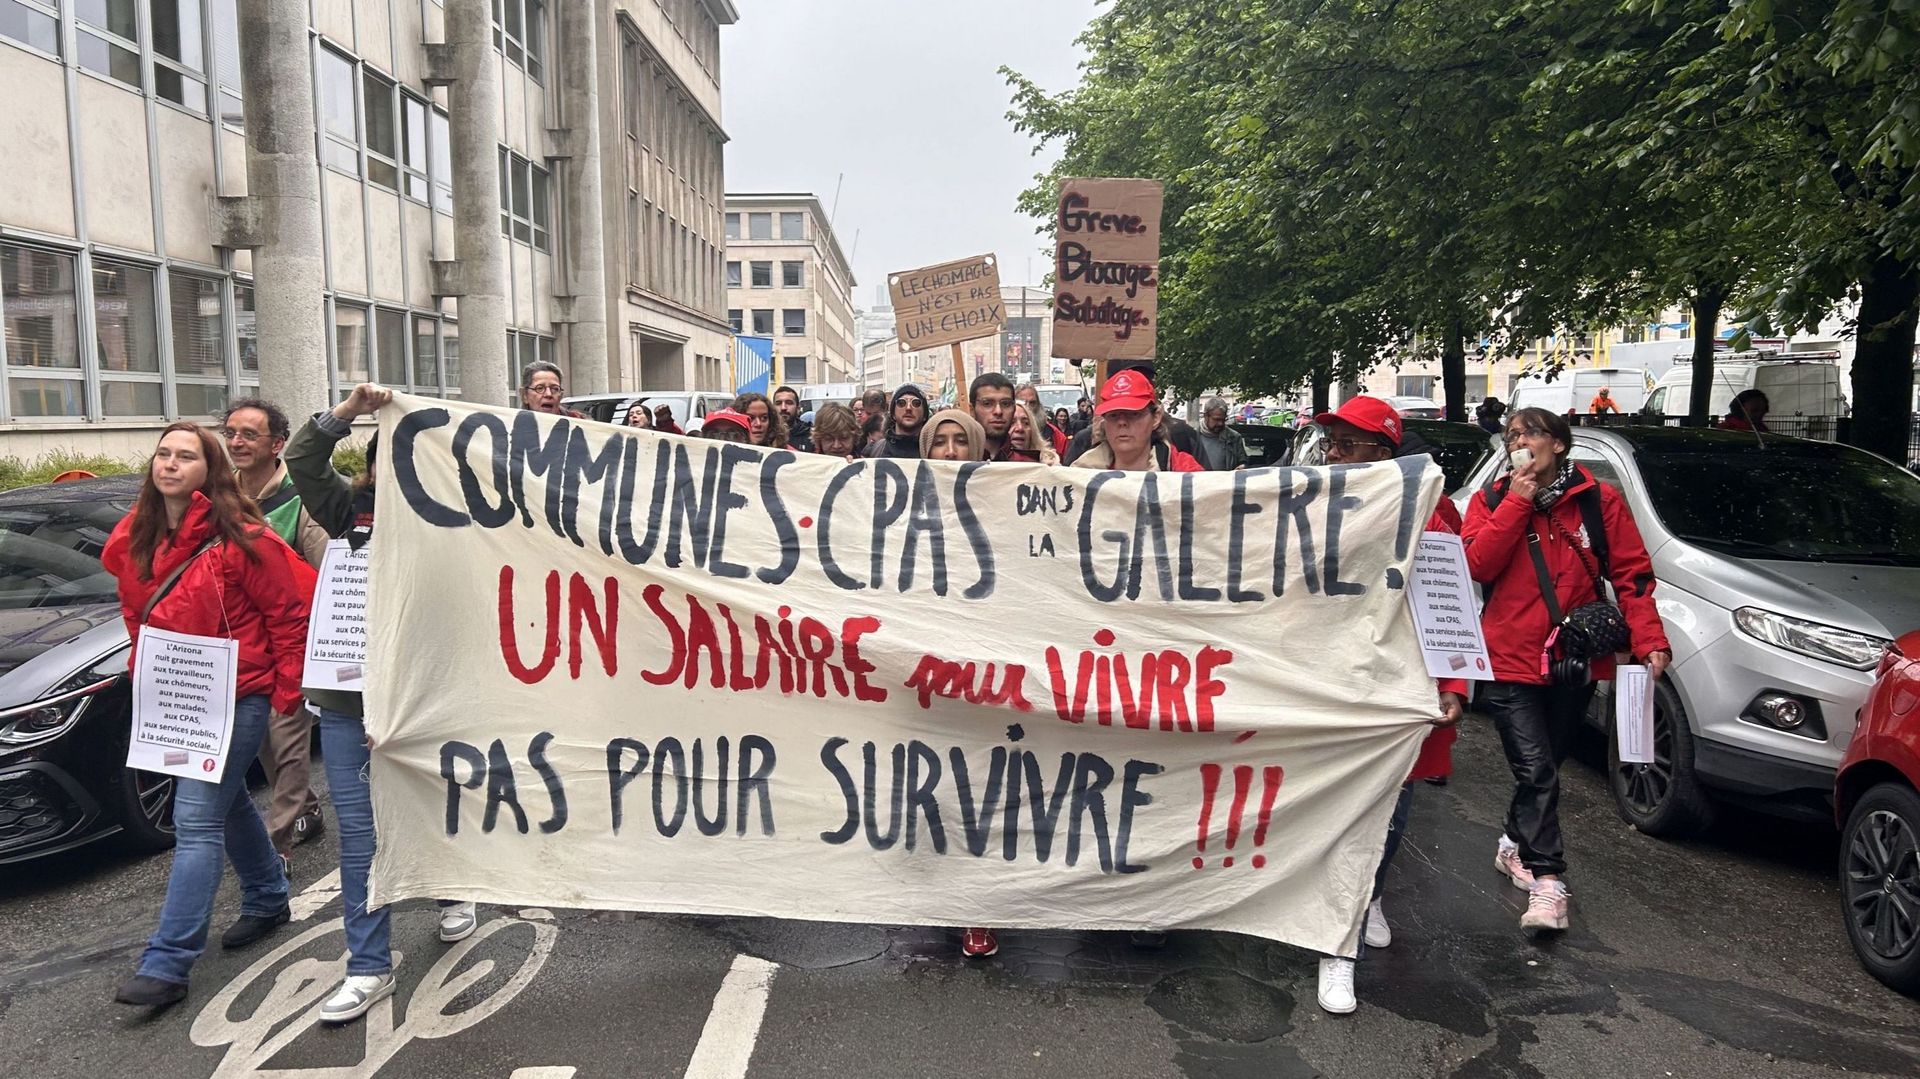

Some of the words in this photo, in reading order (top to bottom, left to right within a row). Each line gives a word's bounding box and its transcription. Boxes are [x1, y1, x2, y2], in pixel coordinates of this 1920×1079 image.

[919, 292, 961, 315] N'EST
[970, 286, 992, 299] PAS
[906, 317, 934, 339] UN
[941, 304, 1001, 332] CHOIX
[1016, 483, 1074, 516] DANS
[1029, 534, 1056, 558] LA
[348, 565, 368, 573] grave
[344, 575, 368, 584] travail
[331, 638, 360, 647] services
[499, 564, 619, 686] UN
[903, 653, 1036, 713] pour
[166, 643, 202, 655] L'Arizona
[319, 649, 326, 657] la
[327, 650, 356, 660] sécurité
[155, 654, 170, 662] nuit
[171, 656, 214, 668] gravement
[153, 665, 167, 674] aux
[168, 667, 215, 680] travailleurs,
[155, 678, 170, 686] aux
[171, 679, 212, 691] chômeurs,
[159, 690, 174, 698] aux
[174, 691, 208, 702] pauvres,
[158, 701, 172, 709] aux
[173, 702, 208, 714] malades,
[164, 712, 178, 720] aux
[179, 713, 201, 725] CPAS,
[144, 721, 158, 729] aux
[159, 723, 189, 734] services
[190, 727, 218, 740] publics,
[147, 732, 154, 741] la
[155, 734, 185, 746] sécurité
[439, 731, 565, 838] PAS
[606, 734, 777, 838] POUR
